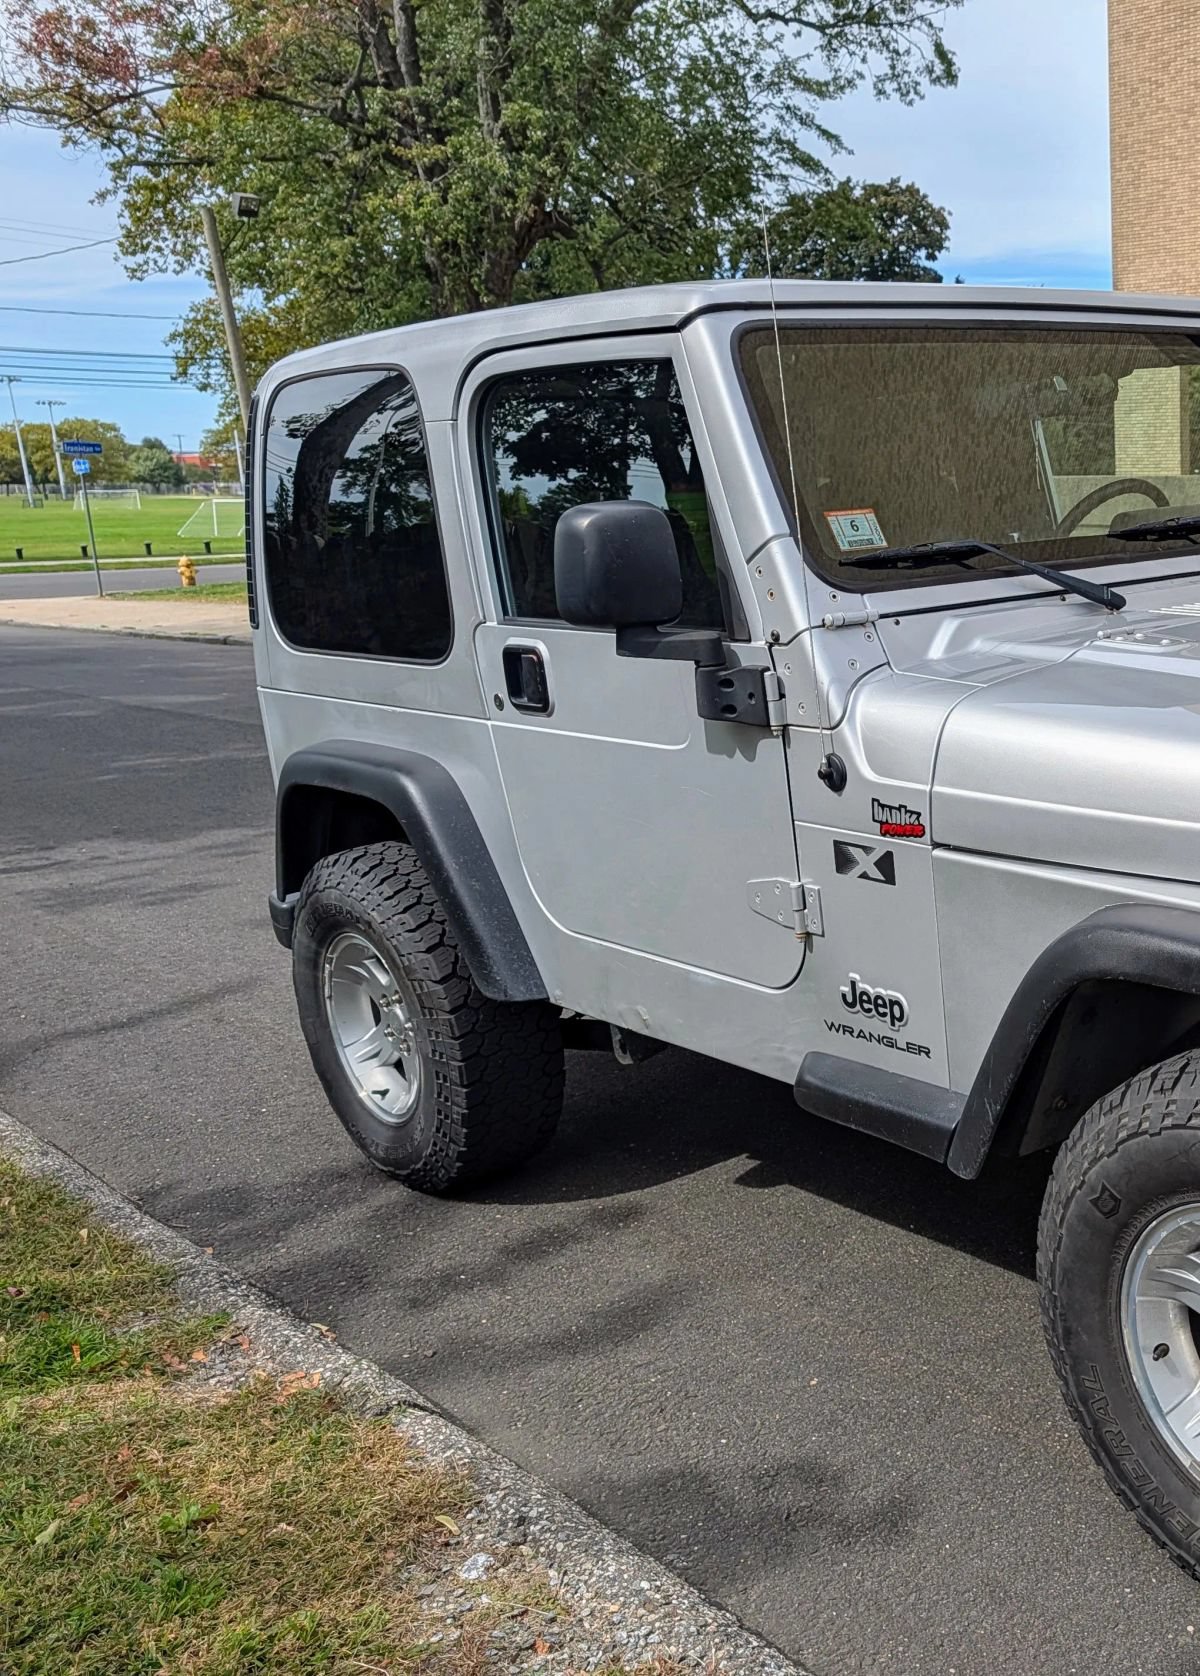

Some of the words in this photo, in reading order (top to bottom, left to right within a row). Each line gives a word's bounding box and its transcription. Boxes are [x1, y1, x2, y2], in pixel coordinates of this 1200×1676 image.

[850, 520, 859, 532] 6
[880, 823, 925, 838] POWER
[840, 842, 896, 884] X
[841, 975, 907, 1029] Jeep
[824, 1020, 932, 1059] WRANGLER
